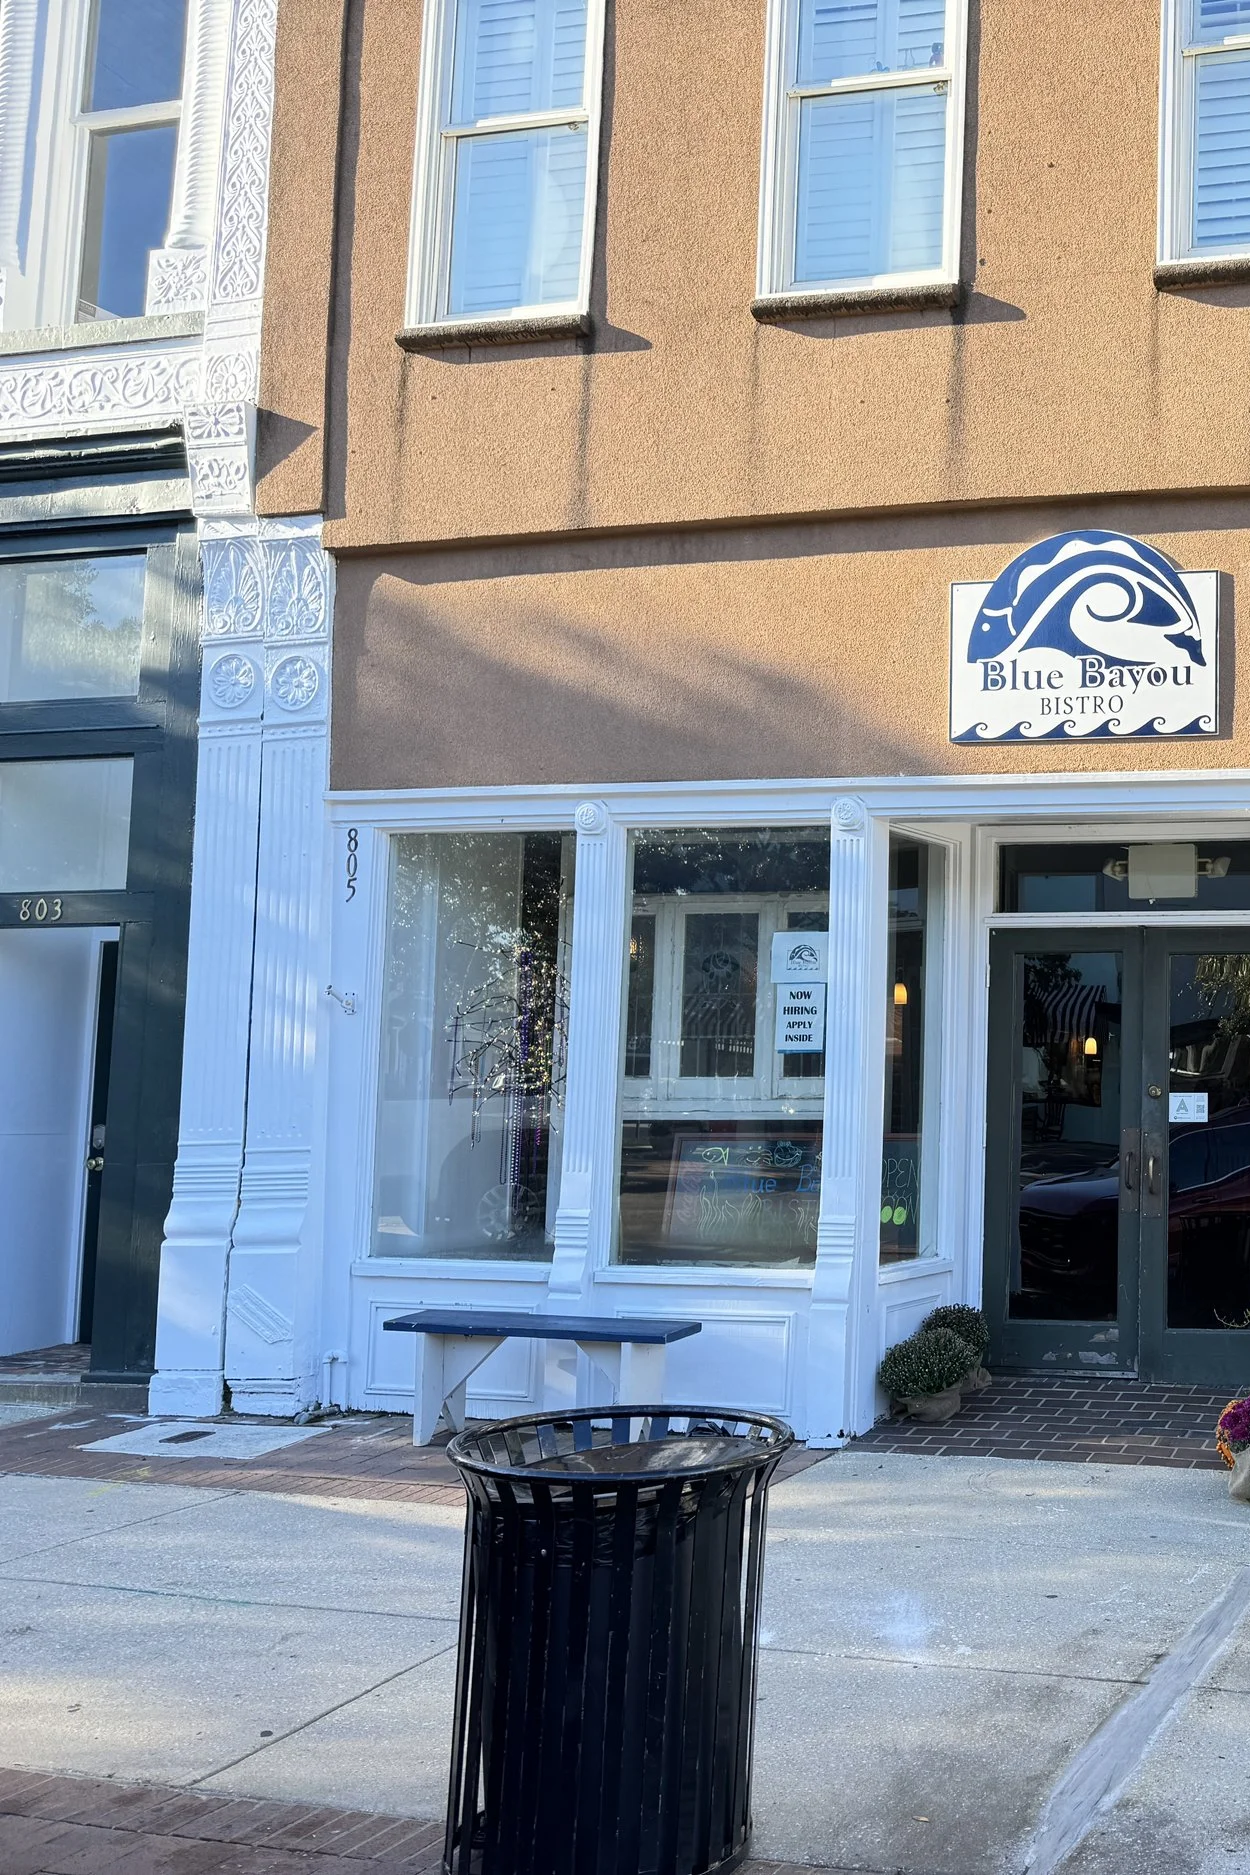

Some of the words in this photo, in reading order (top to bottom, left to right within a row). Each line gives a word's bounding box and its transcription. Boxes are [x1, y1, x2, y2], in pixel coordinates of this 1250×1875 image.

[980, 659, 1064, 693] Blue
[1077, 656, 1195, 695] Bayou
[1040, 695, 1124, 716] BISTRO
[345, 828, 359, 903] 805
[19, 898, 62, 921] 803
[789, 991, 813, 1000] NOW
[783, 1006, 818, 1016] HIRING
[786, 1021, 813, 1030] APPLY
[784, 1034, 813, 1043] INSIDE
[1176, 1098, 1189, 1112] A
